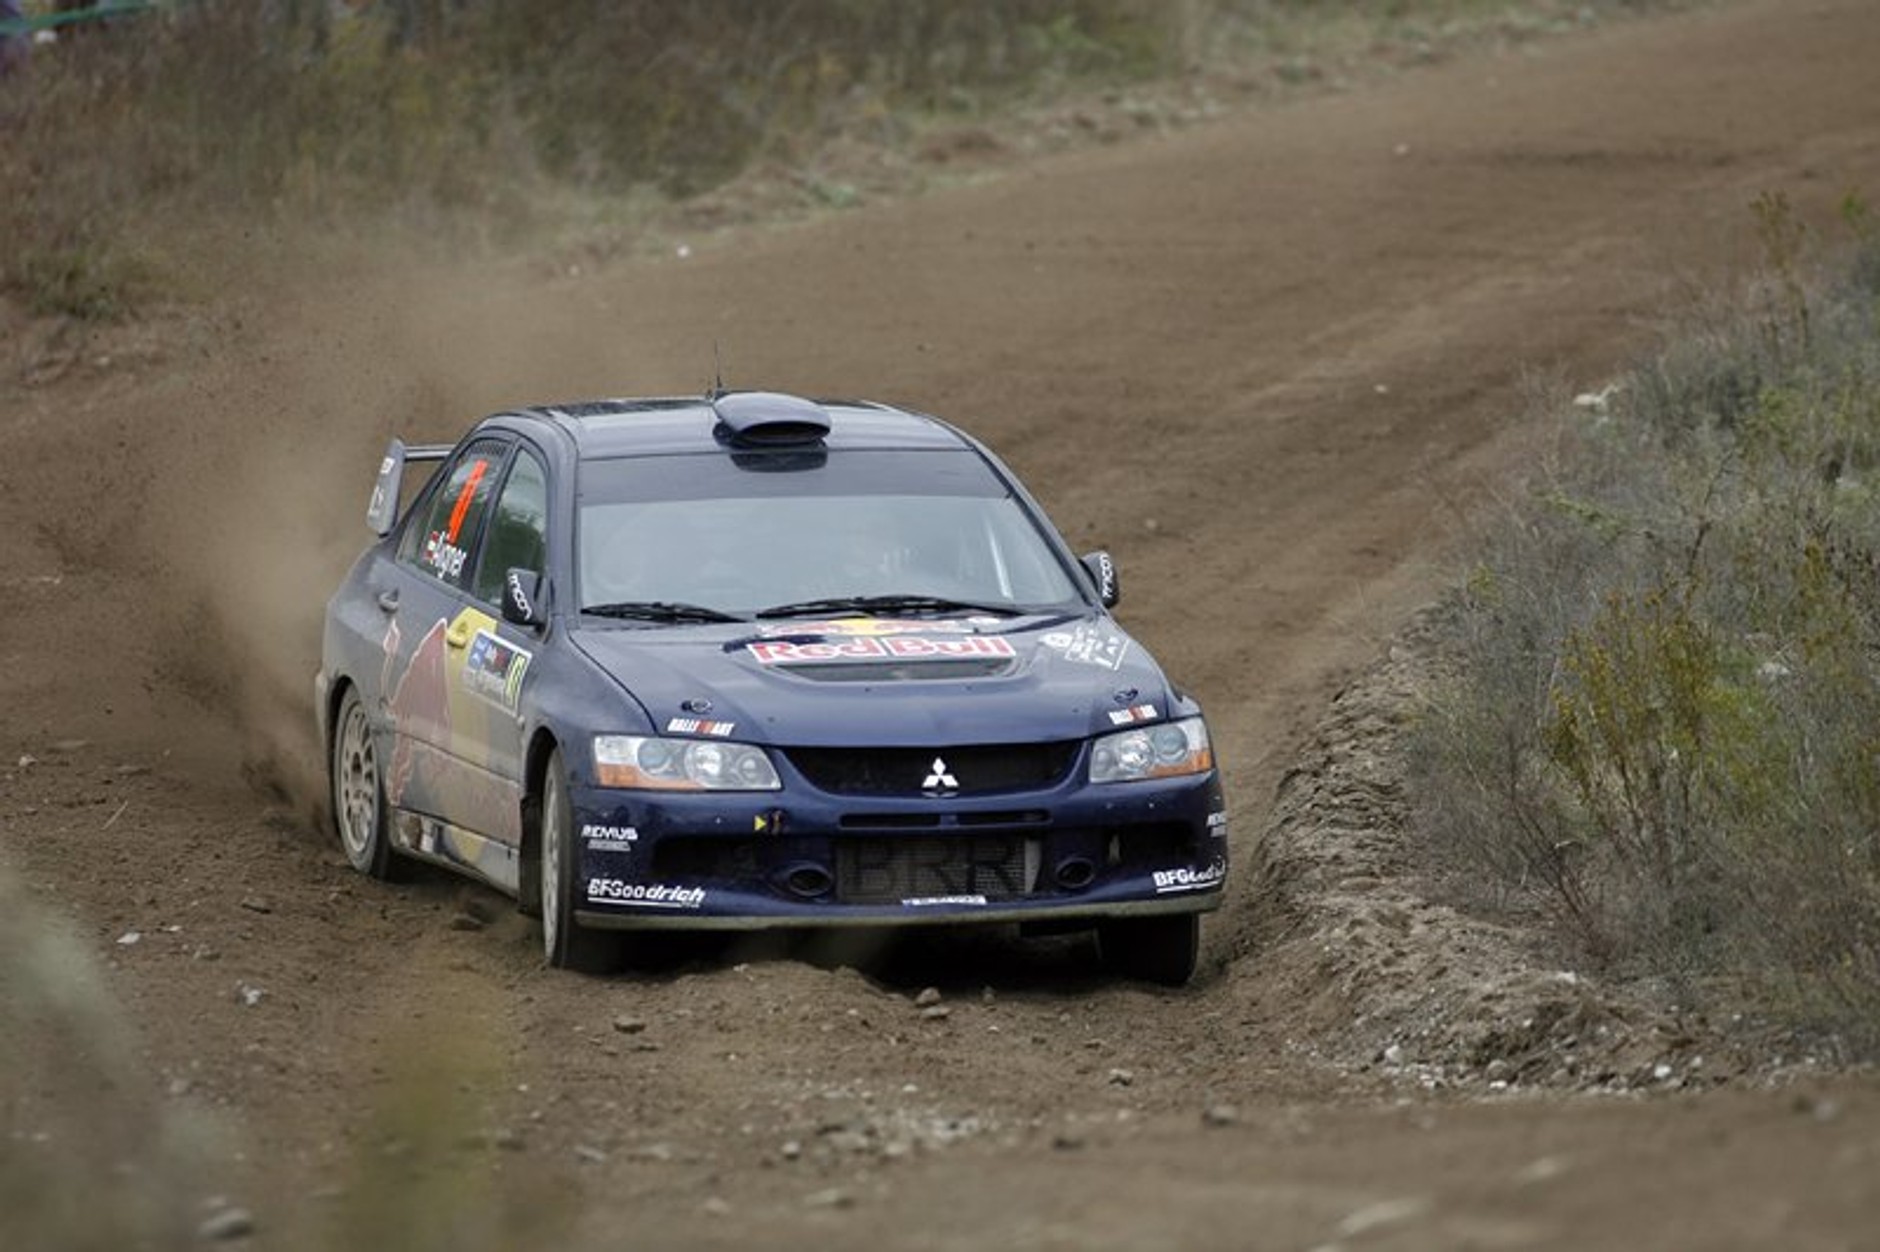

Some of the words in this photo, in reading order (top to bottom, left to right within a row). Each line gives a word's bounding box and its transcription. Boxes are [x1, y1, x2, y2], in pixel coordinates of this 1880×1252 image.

[747, 637, 887, 664] Red
[880, 636, 1017, 658] Bull
[581, 824, 638, 840] REMUS
[587, 877, 707, 902] BFGoodrich
